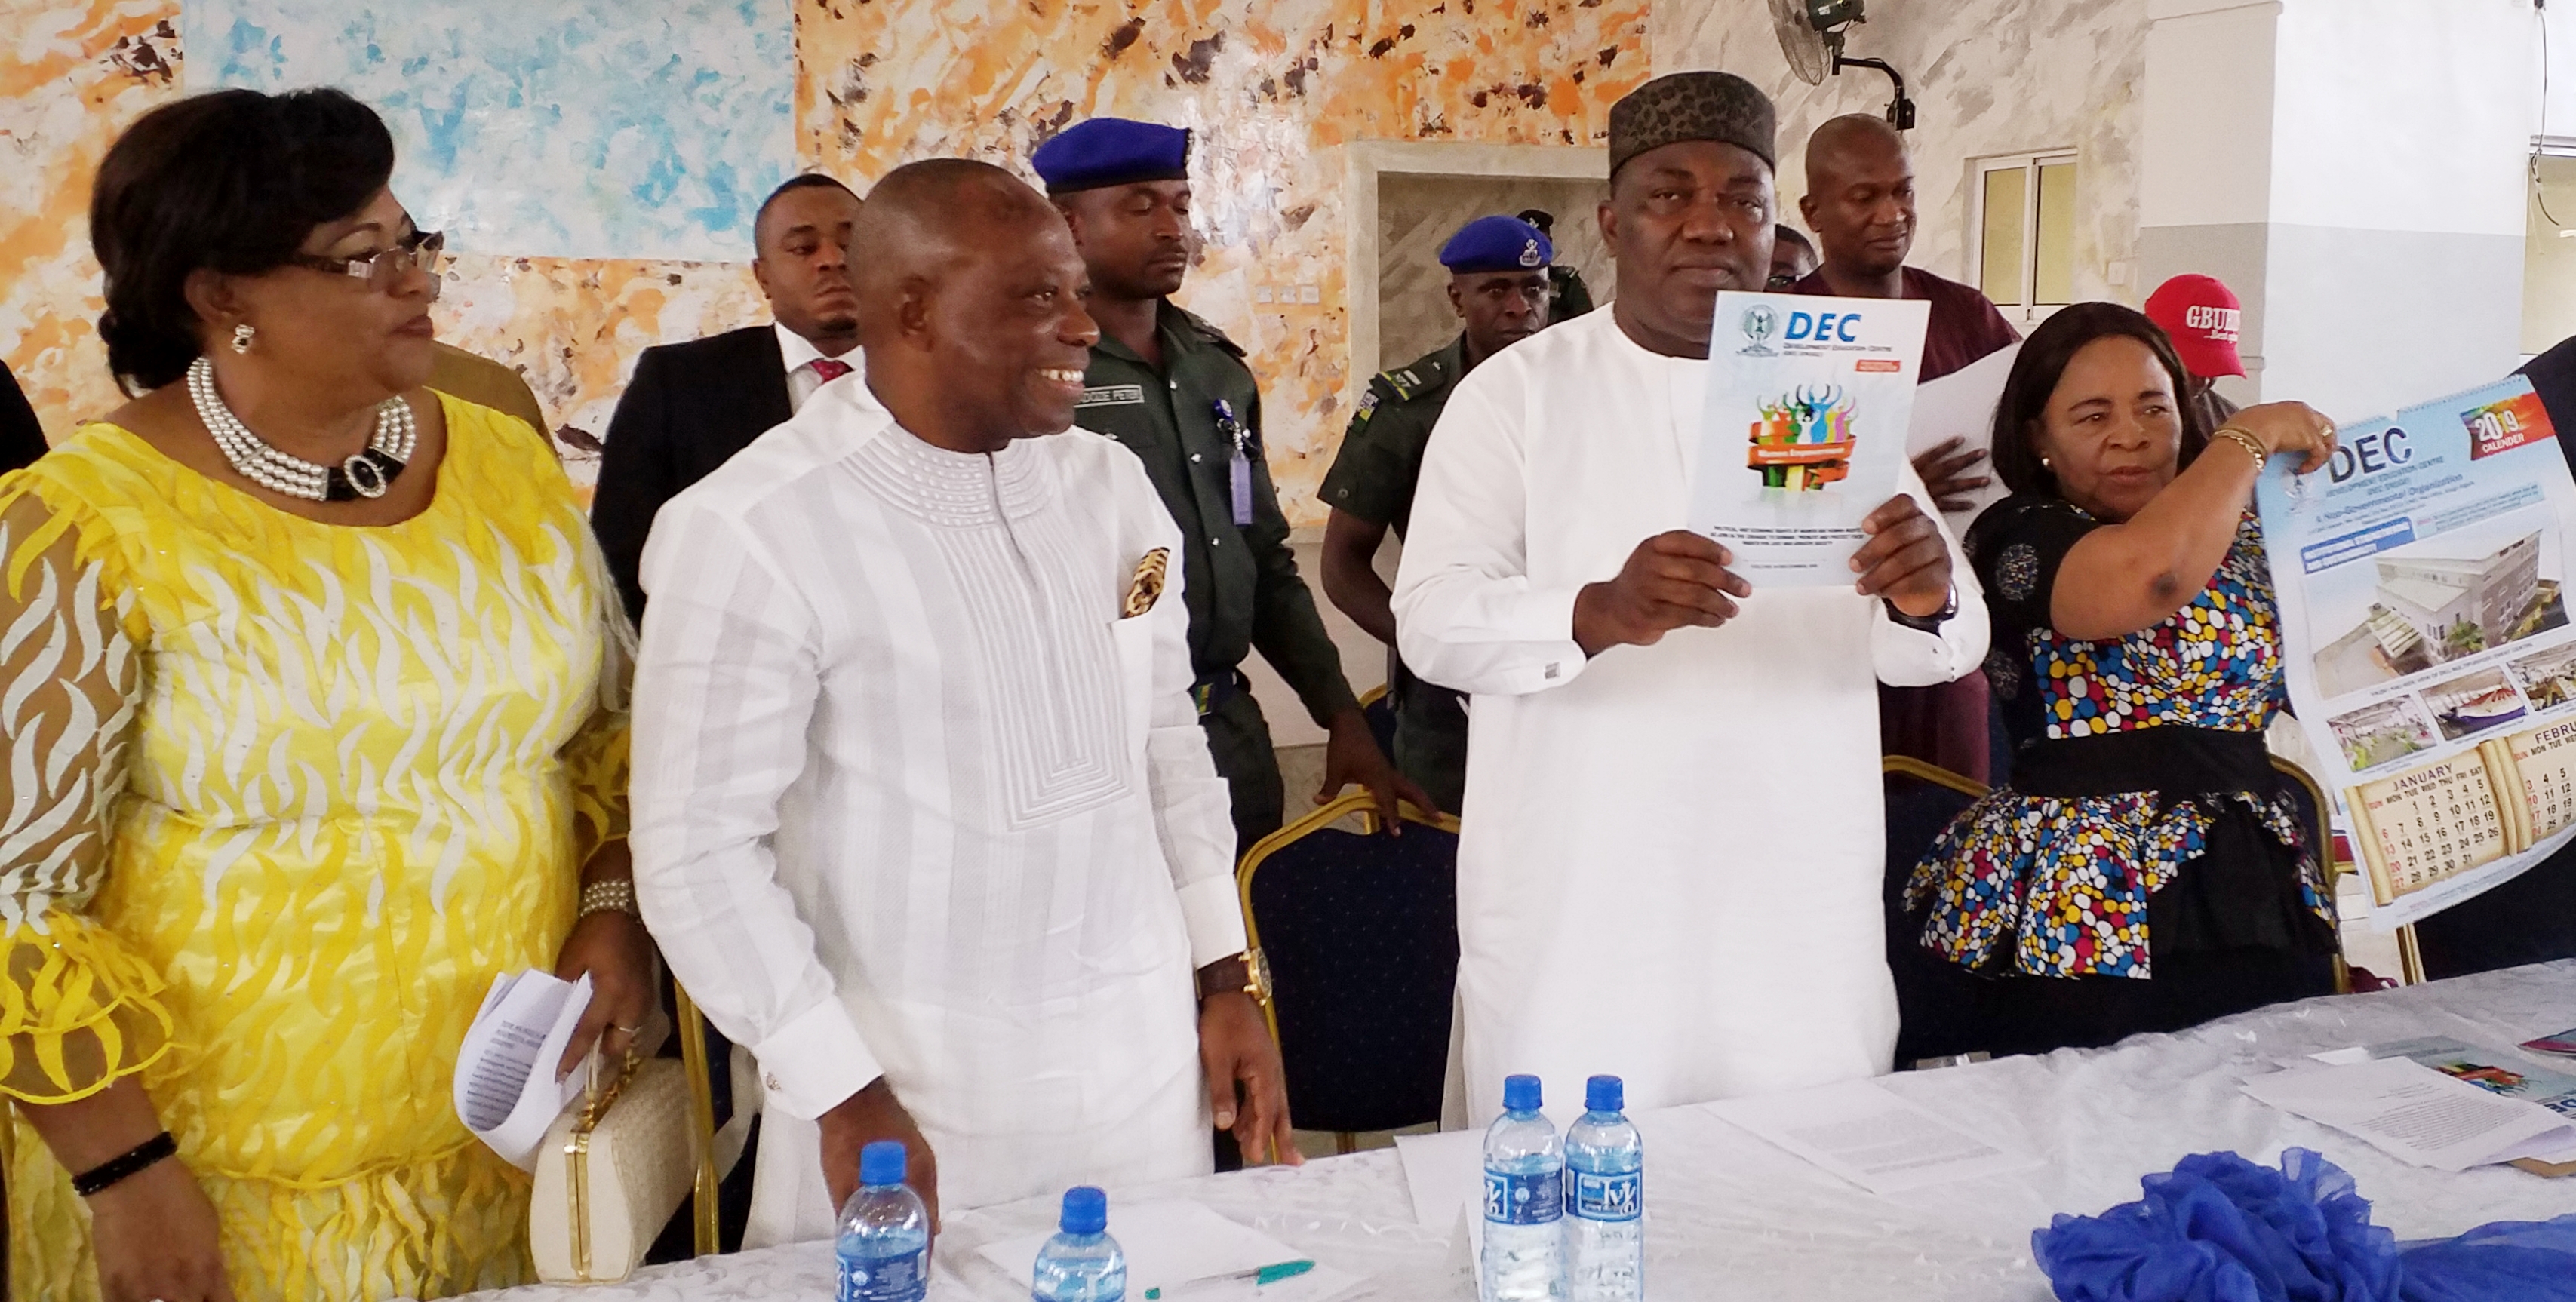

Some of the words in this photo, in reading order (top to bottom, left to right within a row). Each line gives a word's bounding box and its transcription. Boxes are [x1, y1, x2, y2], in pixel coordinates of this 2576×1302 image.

[1784, 311, 1862, 342] DEC
[2475, 410, 2519, 441] 2019
[2329, 428, 2412, 483] DEC
[2482, 433, 2525, 453] CALENDER
[2531, 745, 2547, 755] MON
[2548, 739, 2562, 749] TUE
[2565, 734, 2576, 744] WE
[2535, 721, 2576, 744] FEBRU
[2386, 794, 2402, 803] MON
[2404, 788, 2418, 797] TUE
[2421, 782, 2436, 791] WED
[2438, 777, 2453, 786] THU
[2455, 772, 2467, 781] FRI
[2470, 766, 2482, 776] SAT
[2393, 763, 2452, 791] JANUARY
[2525, 779, 2533, 790] 3
[2543, 773, 2549, 783] 4
[2559, 768, 2566, 778] 5
[2412, 800, 2418, 810] 1
[2429, 795, 2436, 806] 2
[2447, 789, 2454, 800] 3
[2463, 785, 2469, 793] 4
[2477, 779, 2484, 789] 5
[2526, 794, 2538, 806] 10
[2544, 788, 2554, 800] 11
[2561, 782, 2571, 794] 12
[2531, 810, 2540, 821] 17
[2547, 804, 2556, 815] 18
[2563, 797, 2572, 808] 19
[2382, 828, 2388, 839] 6
[2397, 823, 2404, 833] 7
[2417, 817, 2424, 827] 8
[2433, 811, 2439, 821] 9
[2449, 804, 2461, 815] 10
[2465, 799, 2475, 810] 11
[2479, 794, 2491, 806] 12
[2385, 843, 2396, 855] 13
[2401, 838, 2412, 850] 14
[2419, 832, 2430, 843] 15
[2436, 827, 2447, 838] 16
[2455, 821, 2464, 832] 17
[2470, 815, 2480, 827] 18
[2484, 810, 2495, 821] 19
[2389, 861, 2401, 873] 20
[2407, 855, 2418, 867] 21
[2424, 849, 2436, 861] 22
[2441, 843, 2452, 855] 23
[2458, 837, 2470, 849] 24
[2473, 832, 2485, 843] 25
[2488, 827, 2499, 838] 26
[2394, 877, 2404, 888] 27
[2428, 865, 2439, 877] 29
[2444, 858, 2455, 871] 30
[2462, 853, 2473, 864] 31
